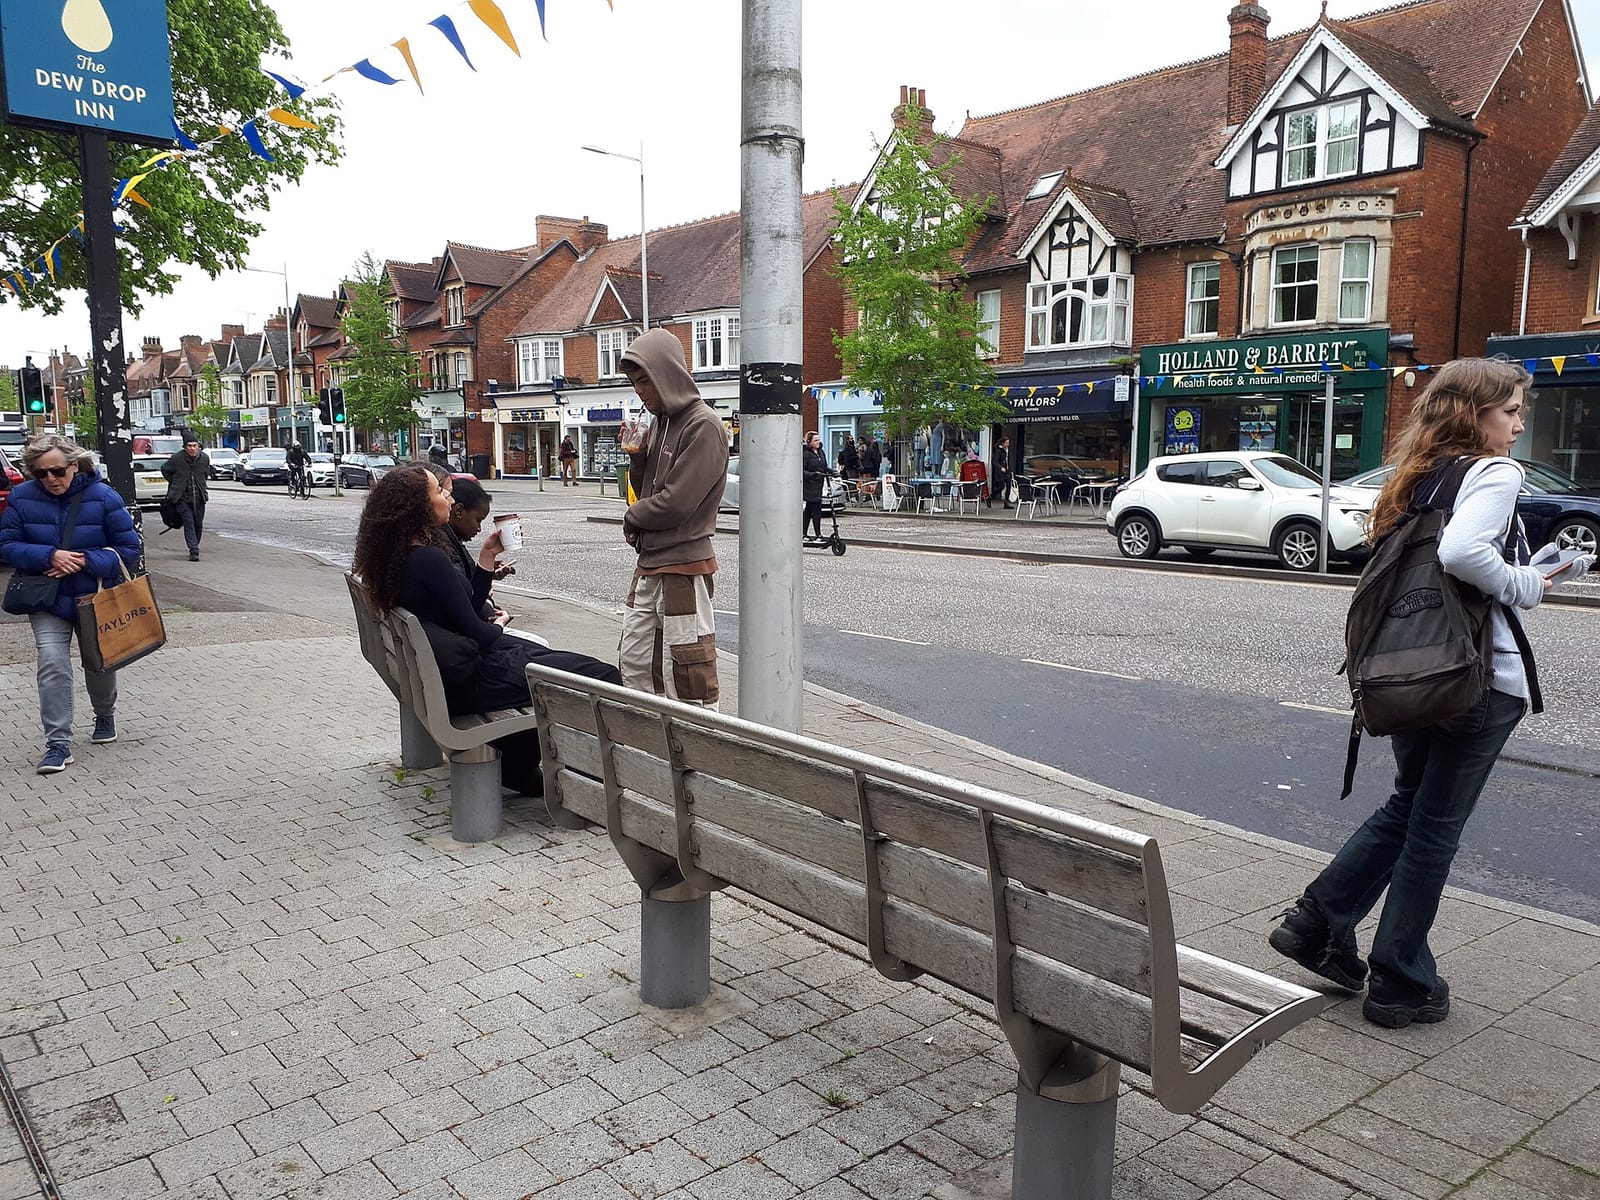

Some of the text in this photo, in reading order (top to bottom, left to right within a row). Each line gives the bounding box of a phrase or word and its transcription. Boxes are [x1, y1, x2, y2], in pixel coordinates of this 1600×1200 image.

[76, 54, 106, 74] The
[35, 68, 147, 103] DEW DROP
[74, 98, 115, 121] INN
[1158, 347, 1239, 374] HOLLAND
[1244, 346, 1260, 369] &
[1178, 377, 1205, 388] health
[1207, 376, 1233, 387] foods
[1237, 375, 1245, 386] &
[1249, 373, 1283, 385] natural
[1176, 416, 1181, 425] 3
[1186, 416, 1191, 425] 2
